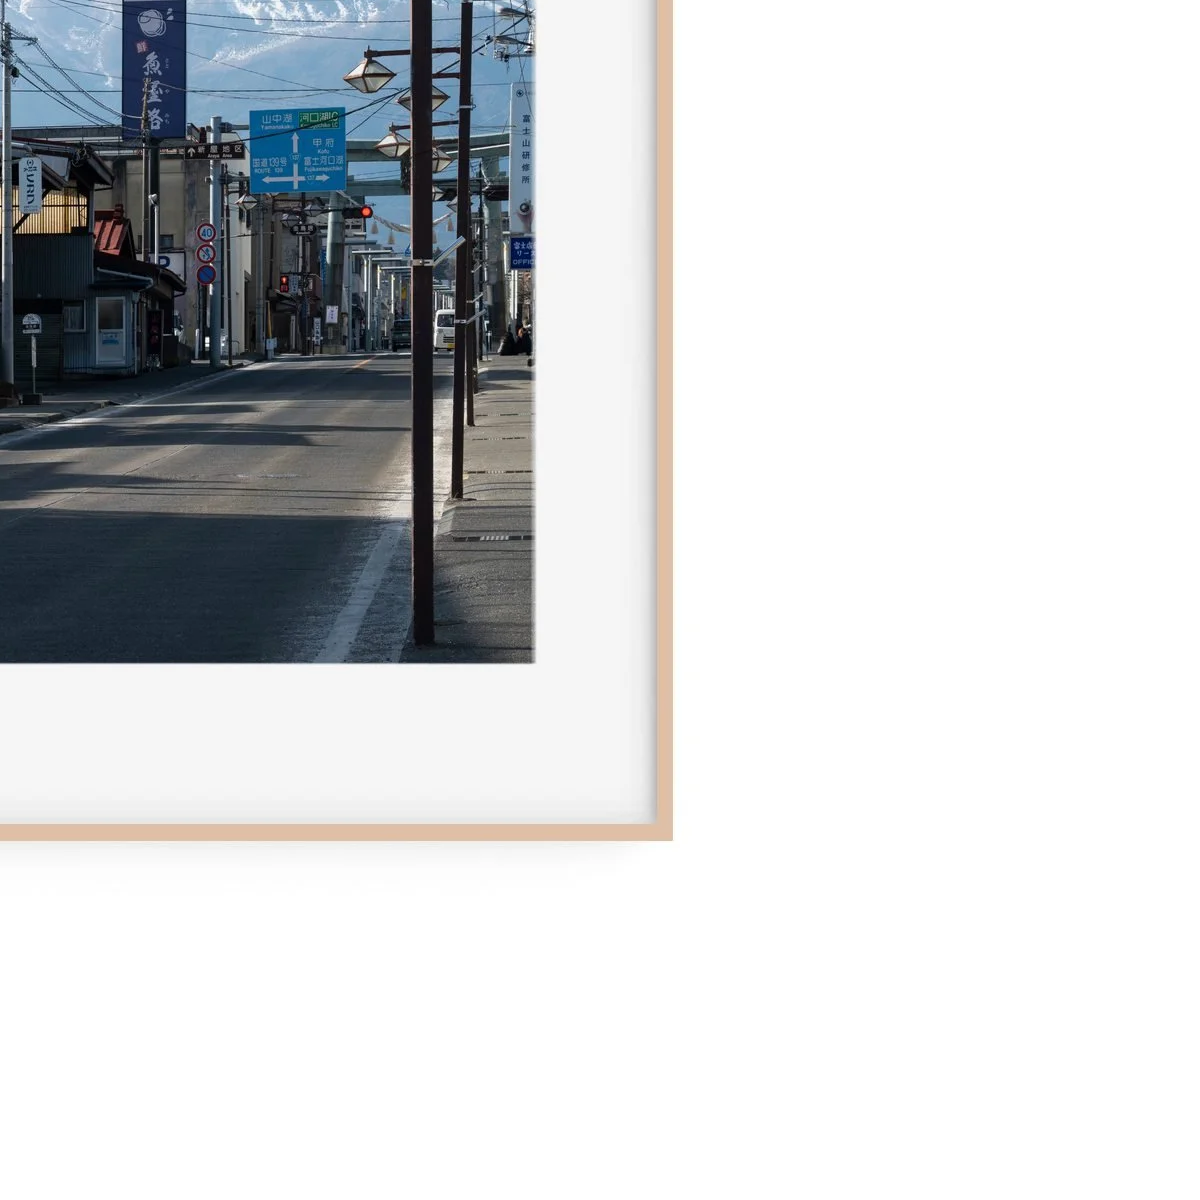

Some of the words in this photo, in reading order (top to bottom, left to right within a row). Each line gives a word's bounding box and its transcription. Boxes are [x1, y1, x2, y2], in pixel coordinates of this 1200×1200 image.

[262, 113, 292, 124] 山中湖
[313, 138, 334, 147] 甲府
[522, 114, 531, 184] 富士山研修所
[202, 228, 212, 238] 40
